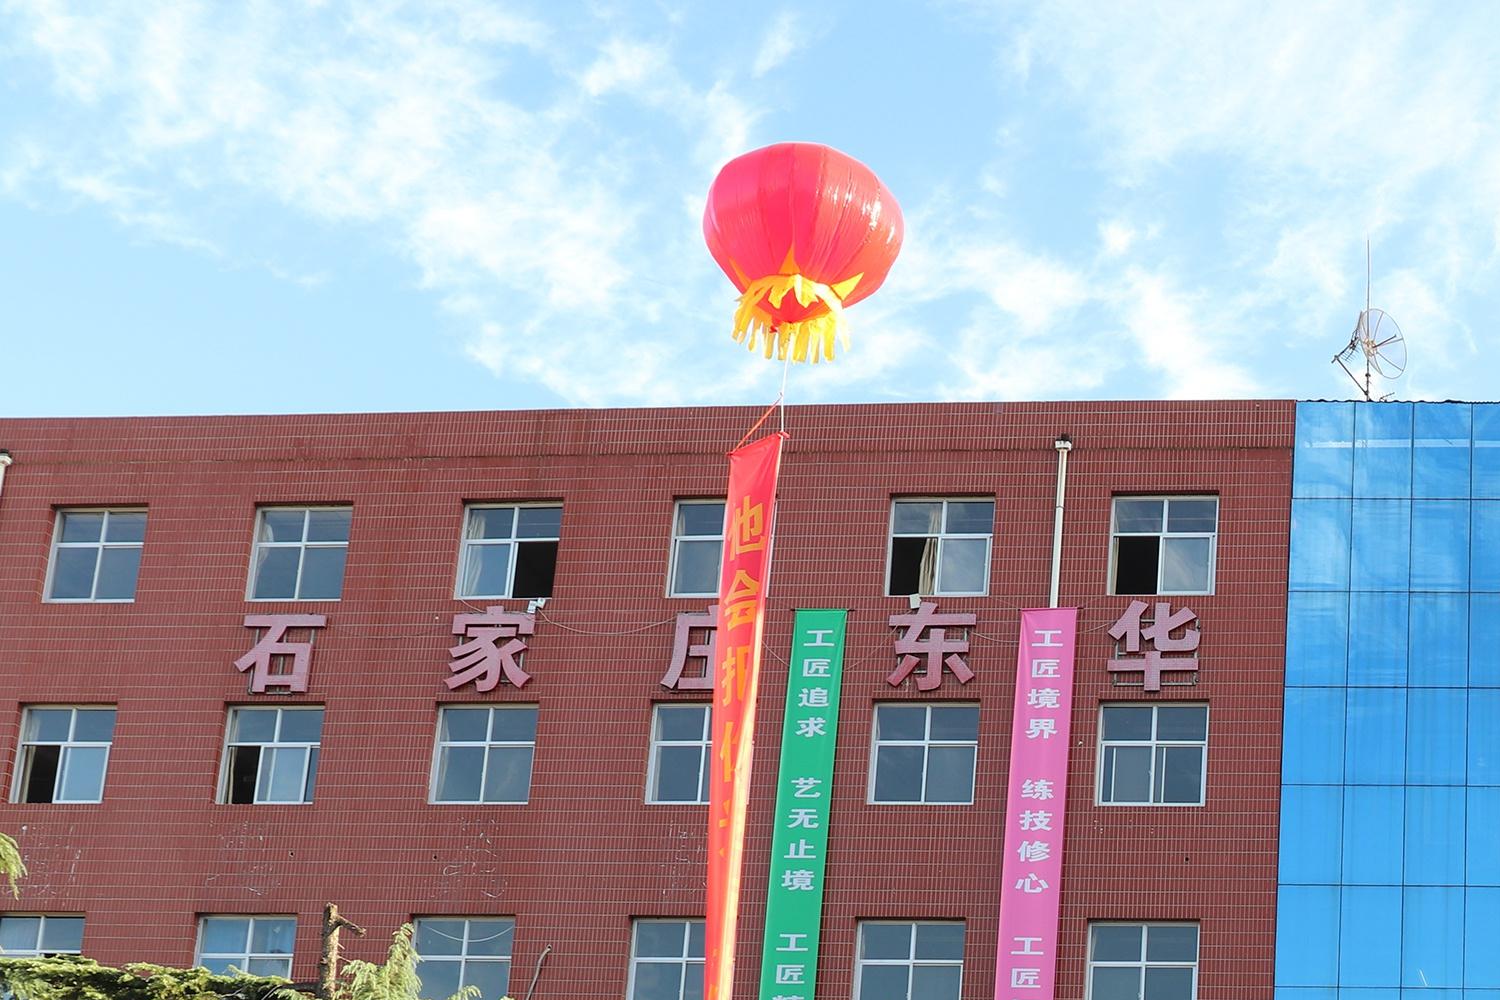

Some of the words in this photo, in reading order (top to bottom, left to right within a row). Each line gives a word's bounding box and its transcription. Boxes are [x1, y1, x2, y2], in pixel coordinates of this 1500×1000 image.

[795, 629, 836, 738] 工匠追求
[1024, 629, 1064, 739] 工匠境界
[781, 777, 822, 892] 艺无止境
[1015, 778, 1054, 894] 练技修心
